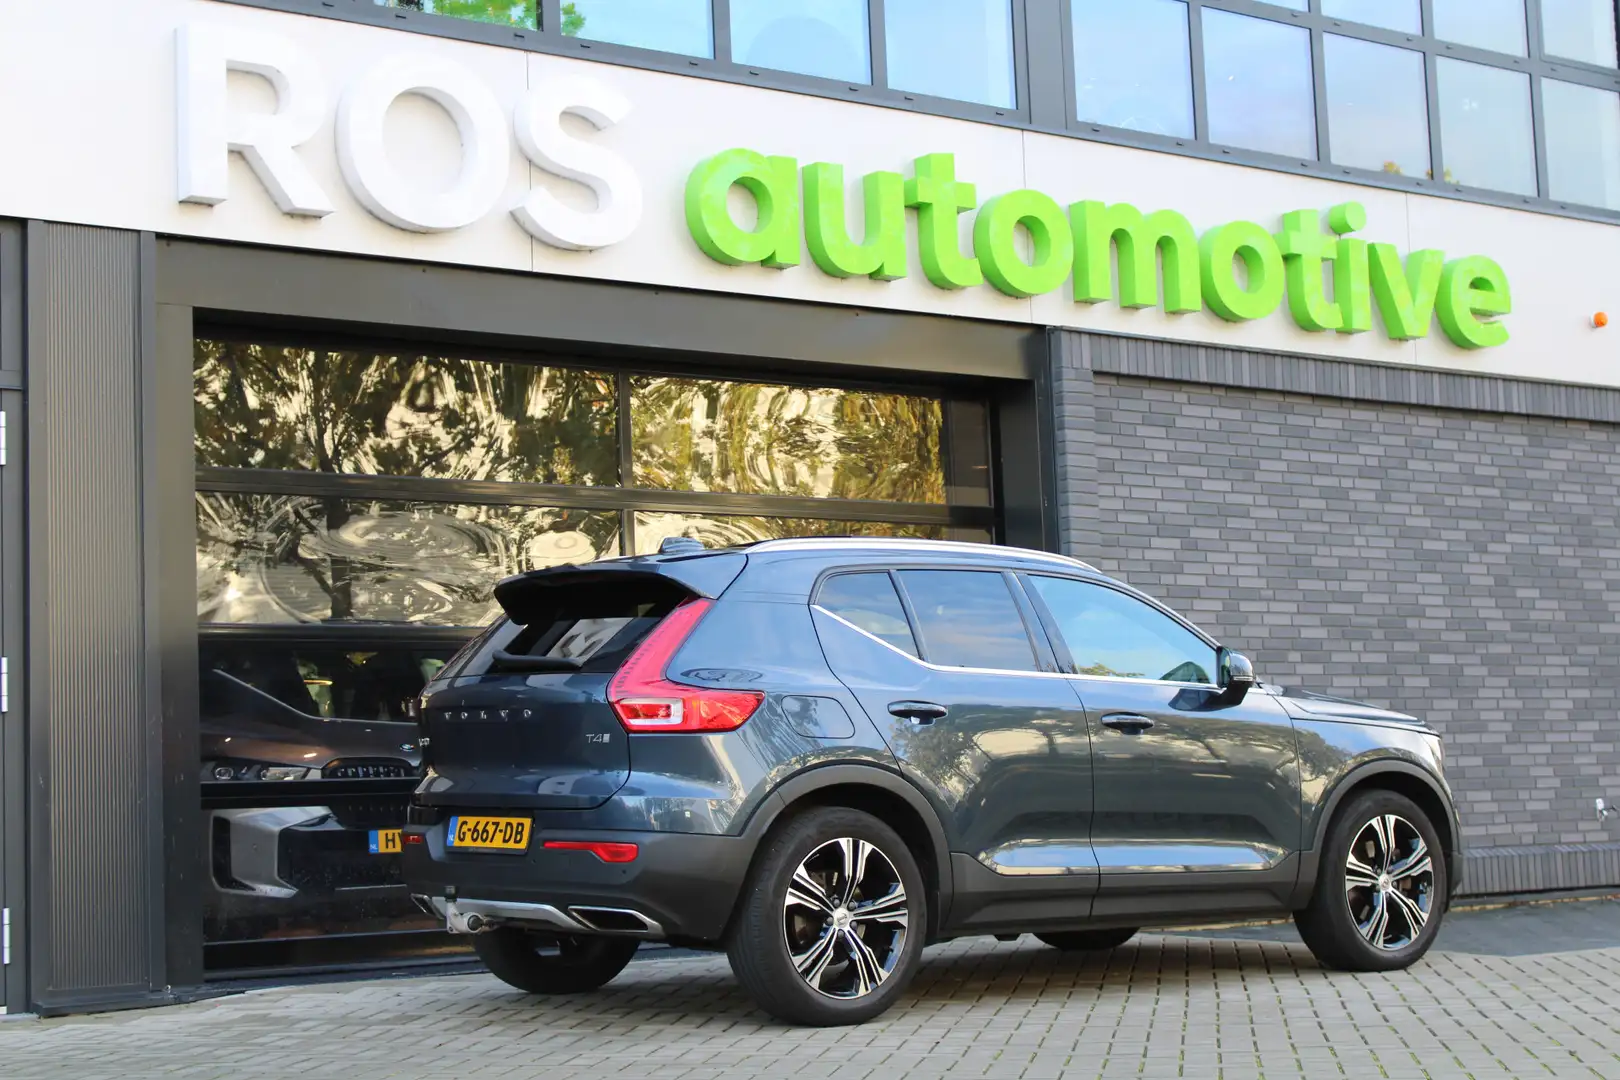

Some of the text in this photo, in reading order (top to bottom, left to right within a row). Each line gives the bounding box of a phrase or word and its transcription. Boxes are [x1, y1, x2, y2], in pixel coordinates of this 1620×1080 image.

[174, 21, 1511, 349] ROS automotive
[444, 709, 532, 720] VOLVO
[586, 733, 603, 743] T4
[458, 820, 525, 844] G-667-DB
